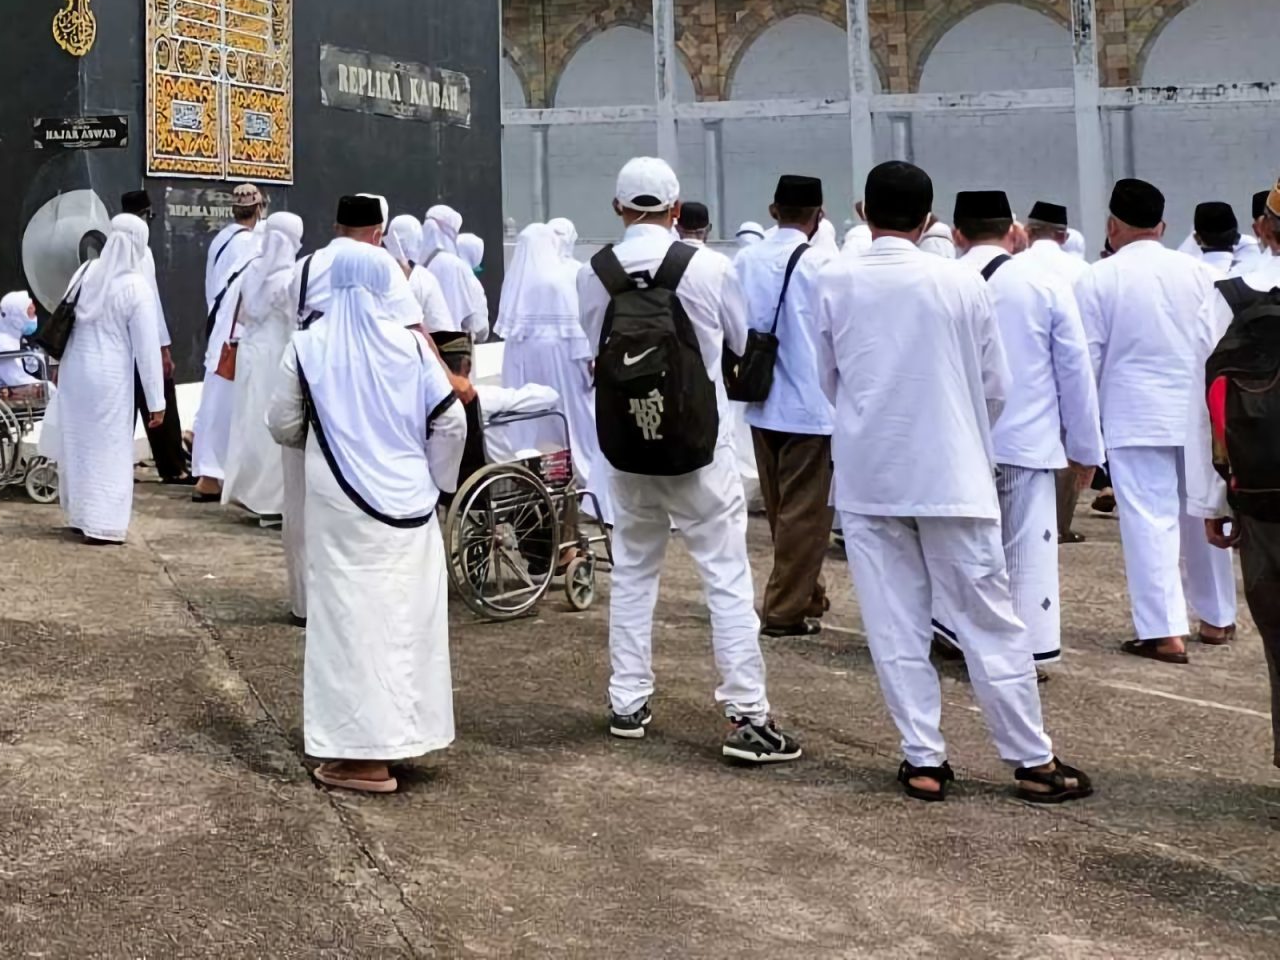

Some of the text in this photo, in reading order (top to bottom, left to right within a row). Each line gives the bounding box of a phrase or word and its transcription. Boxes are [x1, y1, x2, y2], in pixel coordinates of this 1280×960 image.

[338, 63, 402, 102] REPLIKA
[81, 128, 117, 139] ASWAD
[168, 204, 209, 217] REPLIKA
[628, 388, 664, 414] JUST
